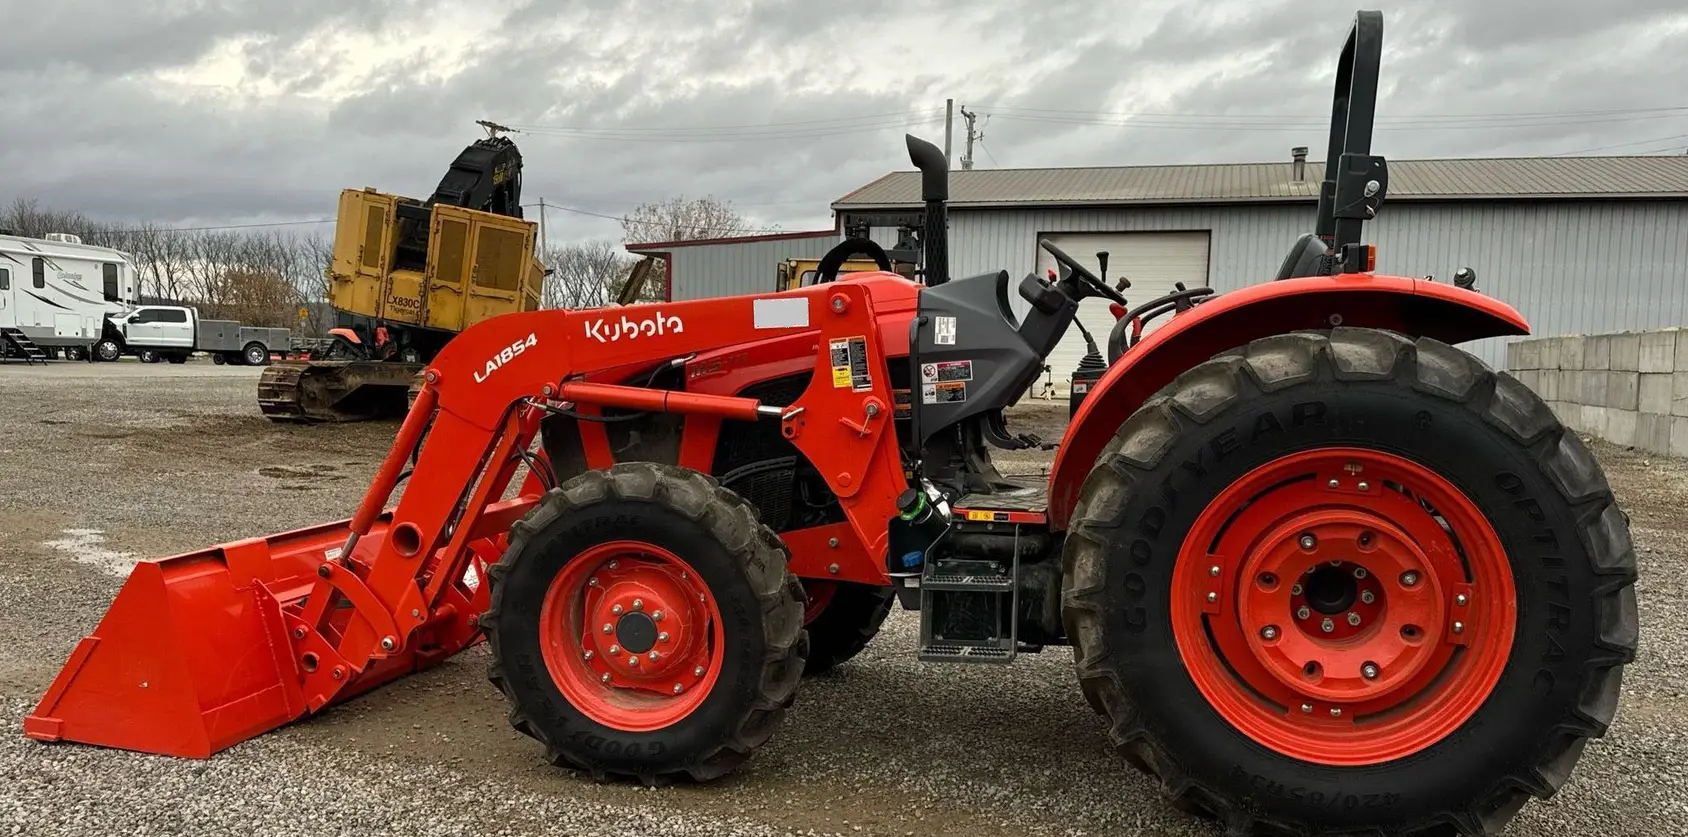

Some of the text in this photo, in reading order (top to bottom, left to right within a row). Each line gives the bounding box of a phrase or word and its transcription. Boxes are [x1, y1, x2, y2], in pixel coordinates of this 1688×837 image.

[386, 295, 420, 309] LX830C
[585, 311, 684, 343] Kubota
[473, 332, 538, 384] LA1854
[1124, 400, 1328, 636] GOODYEAR
[1493, 469, 1572, 698] OPTITRAC
